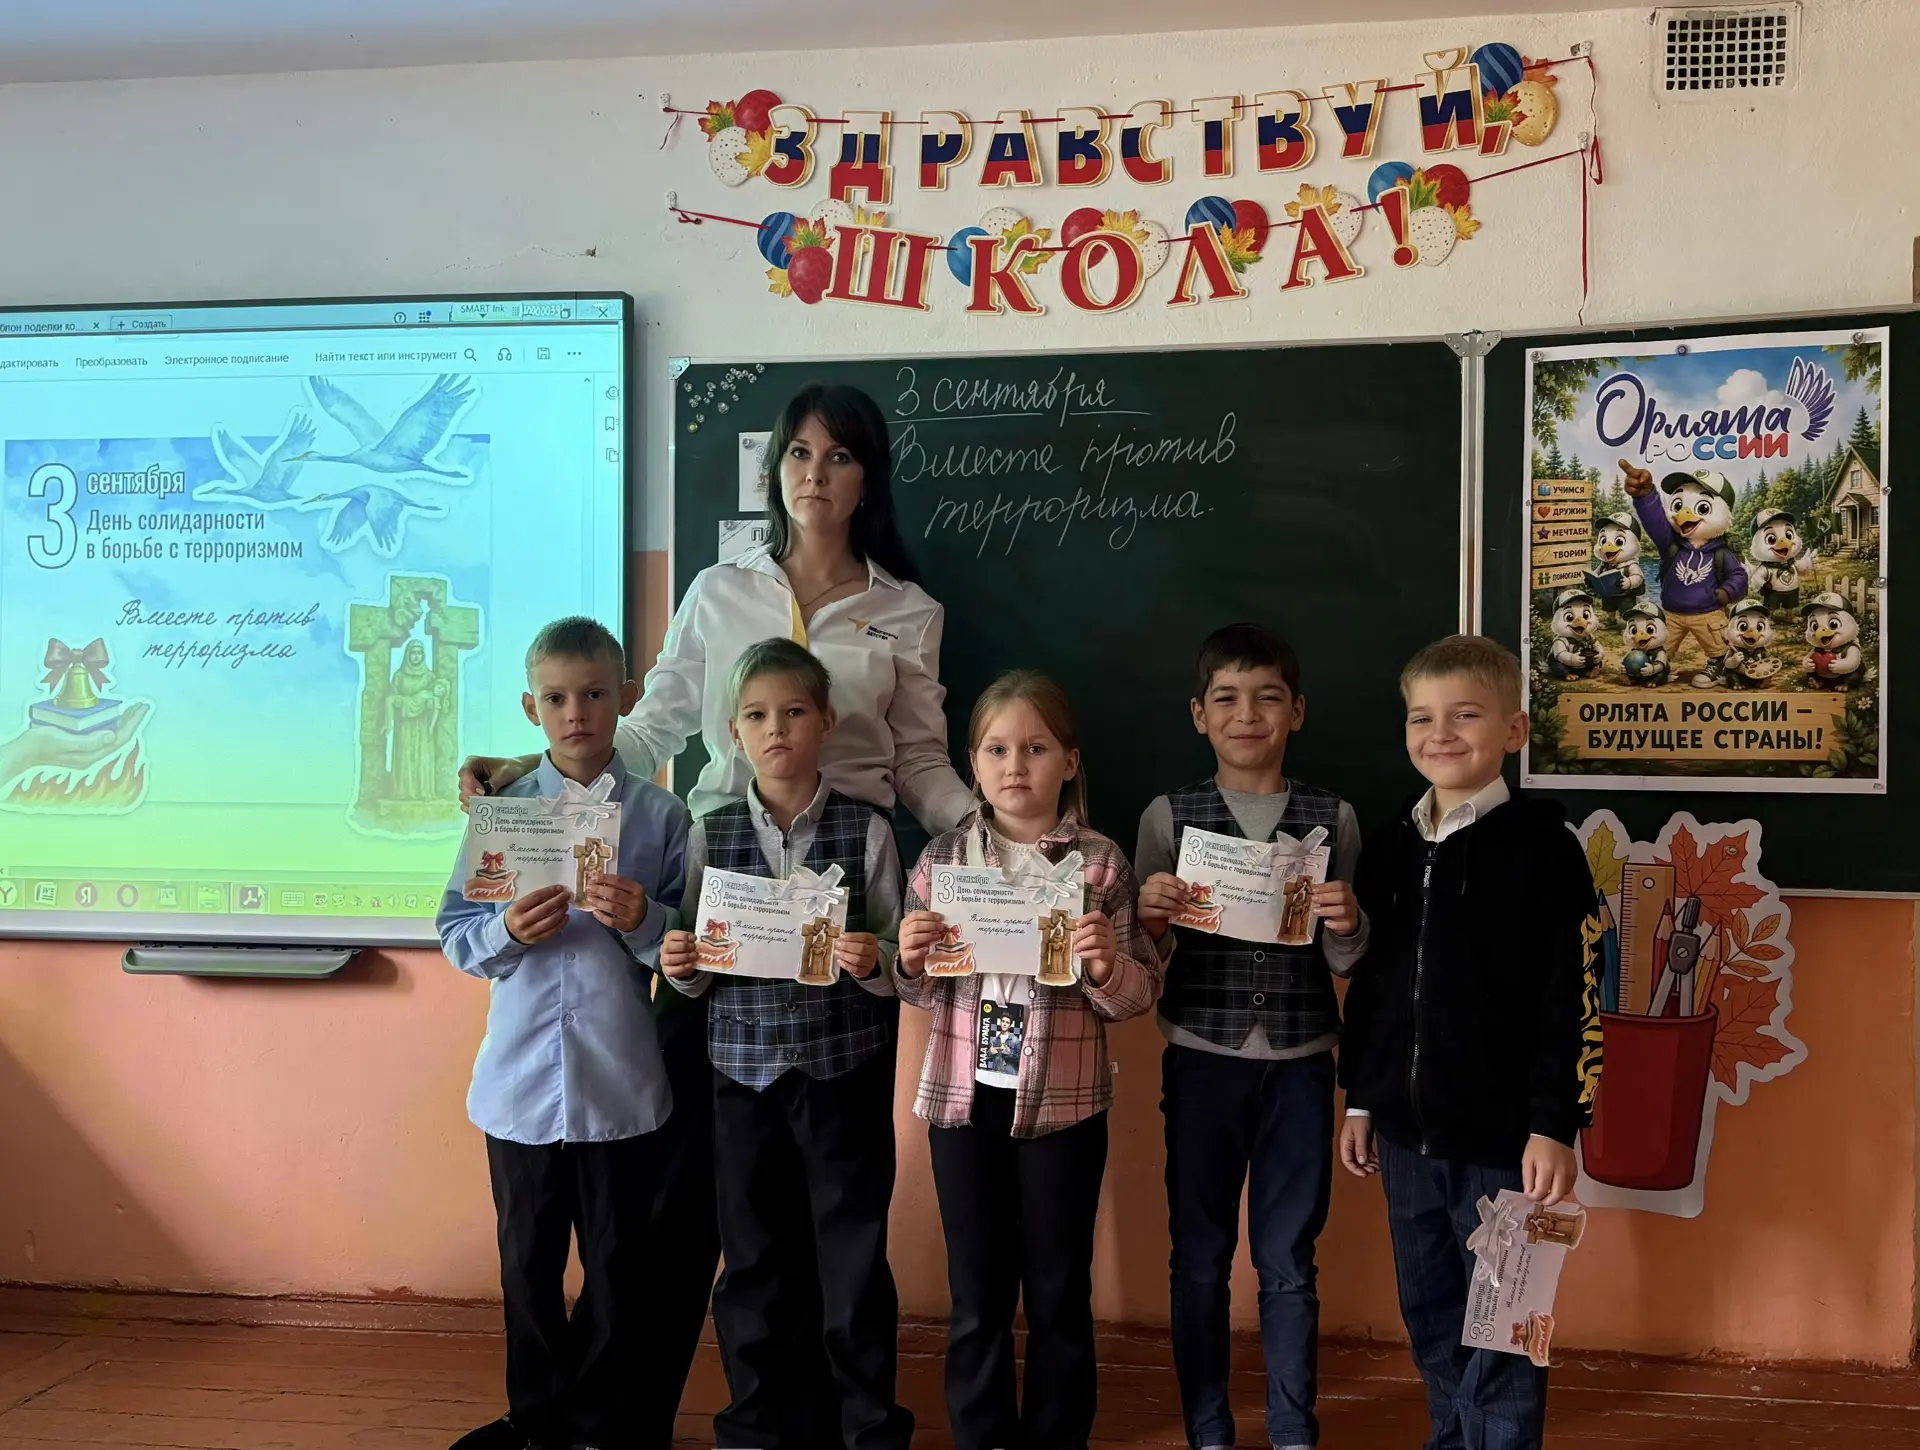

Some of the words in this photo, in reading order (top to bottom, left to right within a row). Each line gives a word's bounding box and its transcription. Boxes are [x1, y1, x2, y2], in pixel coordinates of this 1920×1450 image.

[761, 46, 1512, 205] ЗДРАВСТВУЙ,
[822, 186, 1420, 316] ШКОЛА!
[460, 304, 489, 313] SMART
[493, 304, 505, 312] Ink
[25, 323, 62, 333] поделки
[131, 319, 166, 331] Создать
[75, 357, 148, 369] Преобразовать
[164, 355, 227, 367] Электронное
[230, 353, 290, 365] подписание
[315, 351, 346, 362] Найти
[348, 352, 374, 361] текст
[377, 352, 396, 361] или
[399, 350, 457, 363] инструмент
[895, 366, 920, 417] 3
[933, 366, 1116, 427] сентября
[1596, 371, 1793, 455] Орлята
[889, 423, 1064, 482] Вместе
[1080, 411, 1236, 499] против
[1553, 486, 1585, 495] УЧИМСЯ
[27, 462, 78, 570] 3
[87, 463, 185, 499] сентября
[87, 509, 132, 535] День
[138, 510, 265, 535] солидарности
[1552, 507, 1587, 517] ДРУЖИМ
[1552, 527, 1588, 537] МЕЧТАЕМ
[87, 542, 95, 559] в
[102, 537, 162, 563] борьбе
[169, 541, 178, 559] с
[185, 540, 303, 563] терроризмом
[1553, 548, 1587, 559] ТВОРИМ
[1552, 571, 1582, 581] ПОМОГАЕМ
[116, 598, 217, 627] Вместе
[226, 602, 320, 637] против
[142, 641, 297, 669] терроризма
[1579, 702, 1668, 723] ОРЛЯТА
[1681, 700, 1788, 723] РОССИИ
[1588, 729, 1703, 752] БУДУЩЕЕ
[1713, 727, 1823, 750] СТРАНЫ!
[475, 803, 493, 835] 3
[1185, 835, 1204, 866] 3
[706, 876, 723, 907] 3
[938, 872, 954, 903] 3
[957, 886, 972, 894] День
[981, 1017, 991, 1045] БУМАГА
[979, 1047, 988, 1068] ВЛАД
[1469, 1322, 1495, 1342] 3
